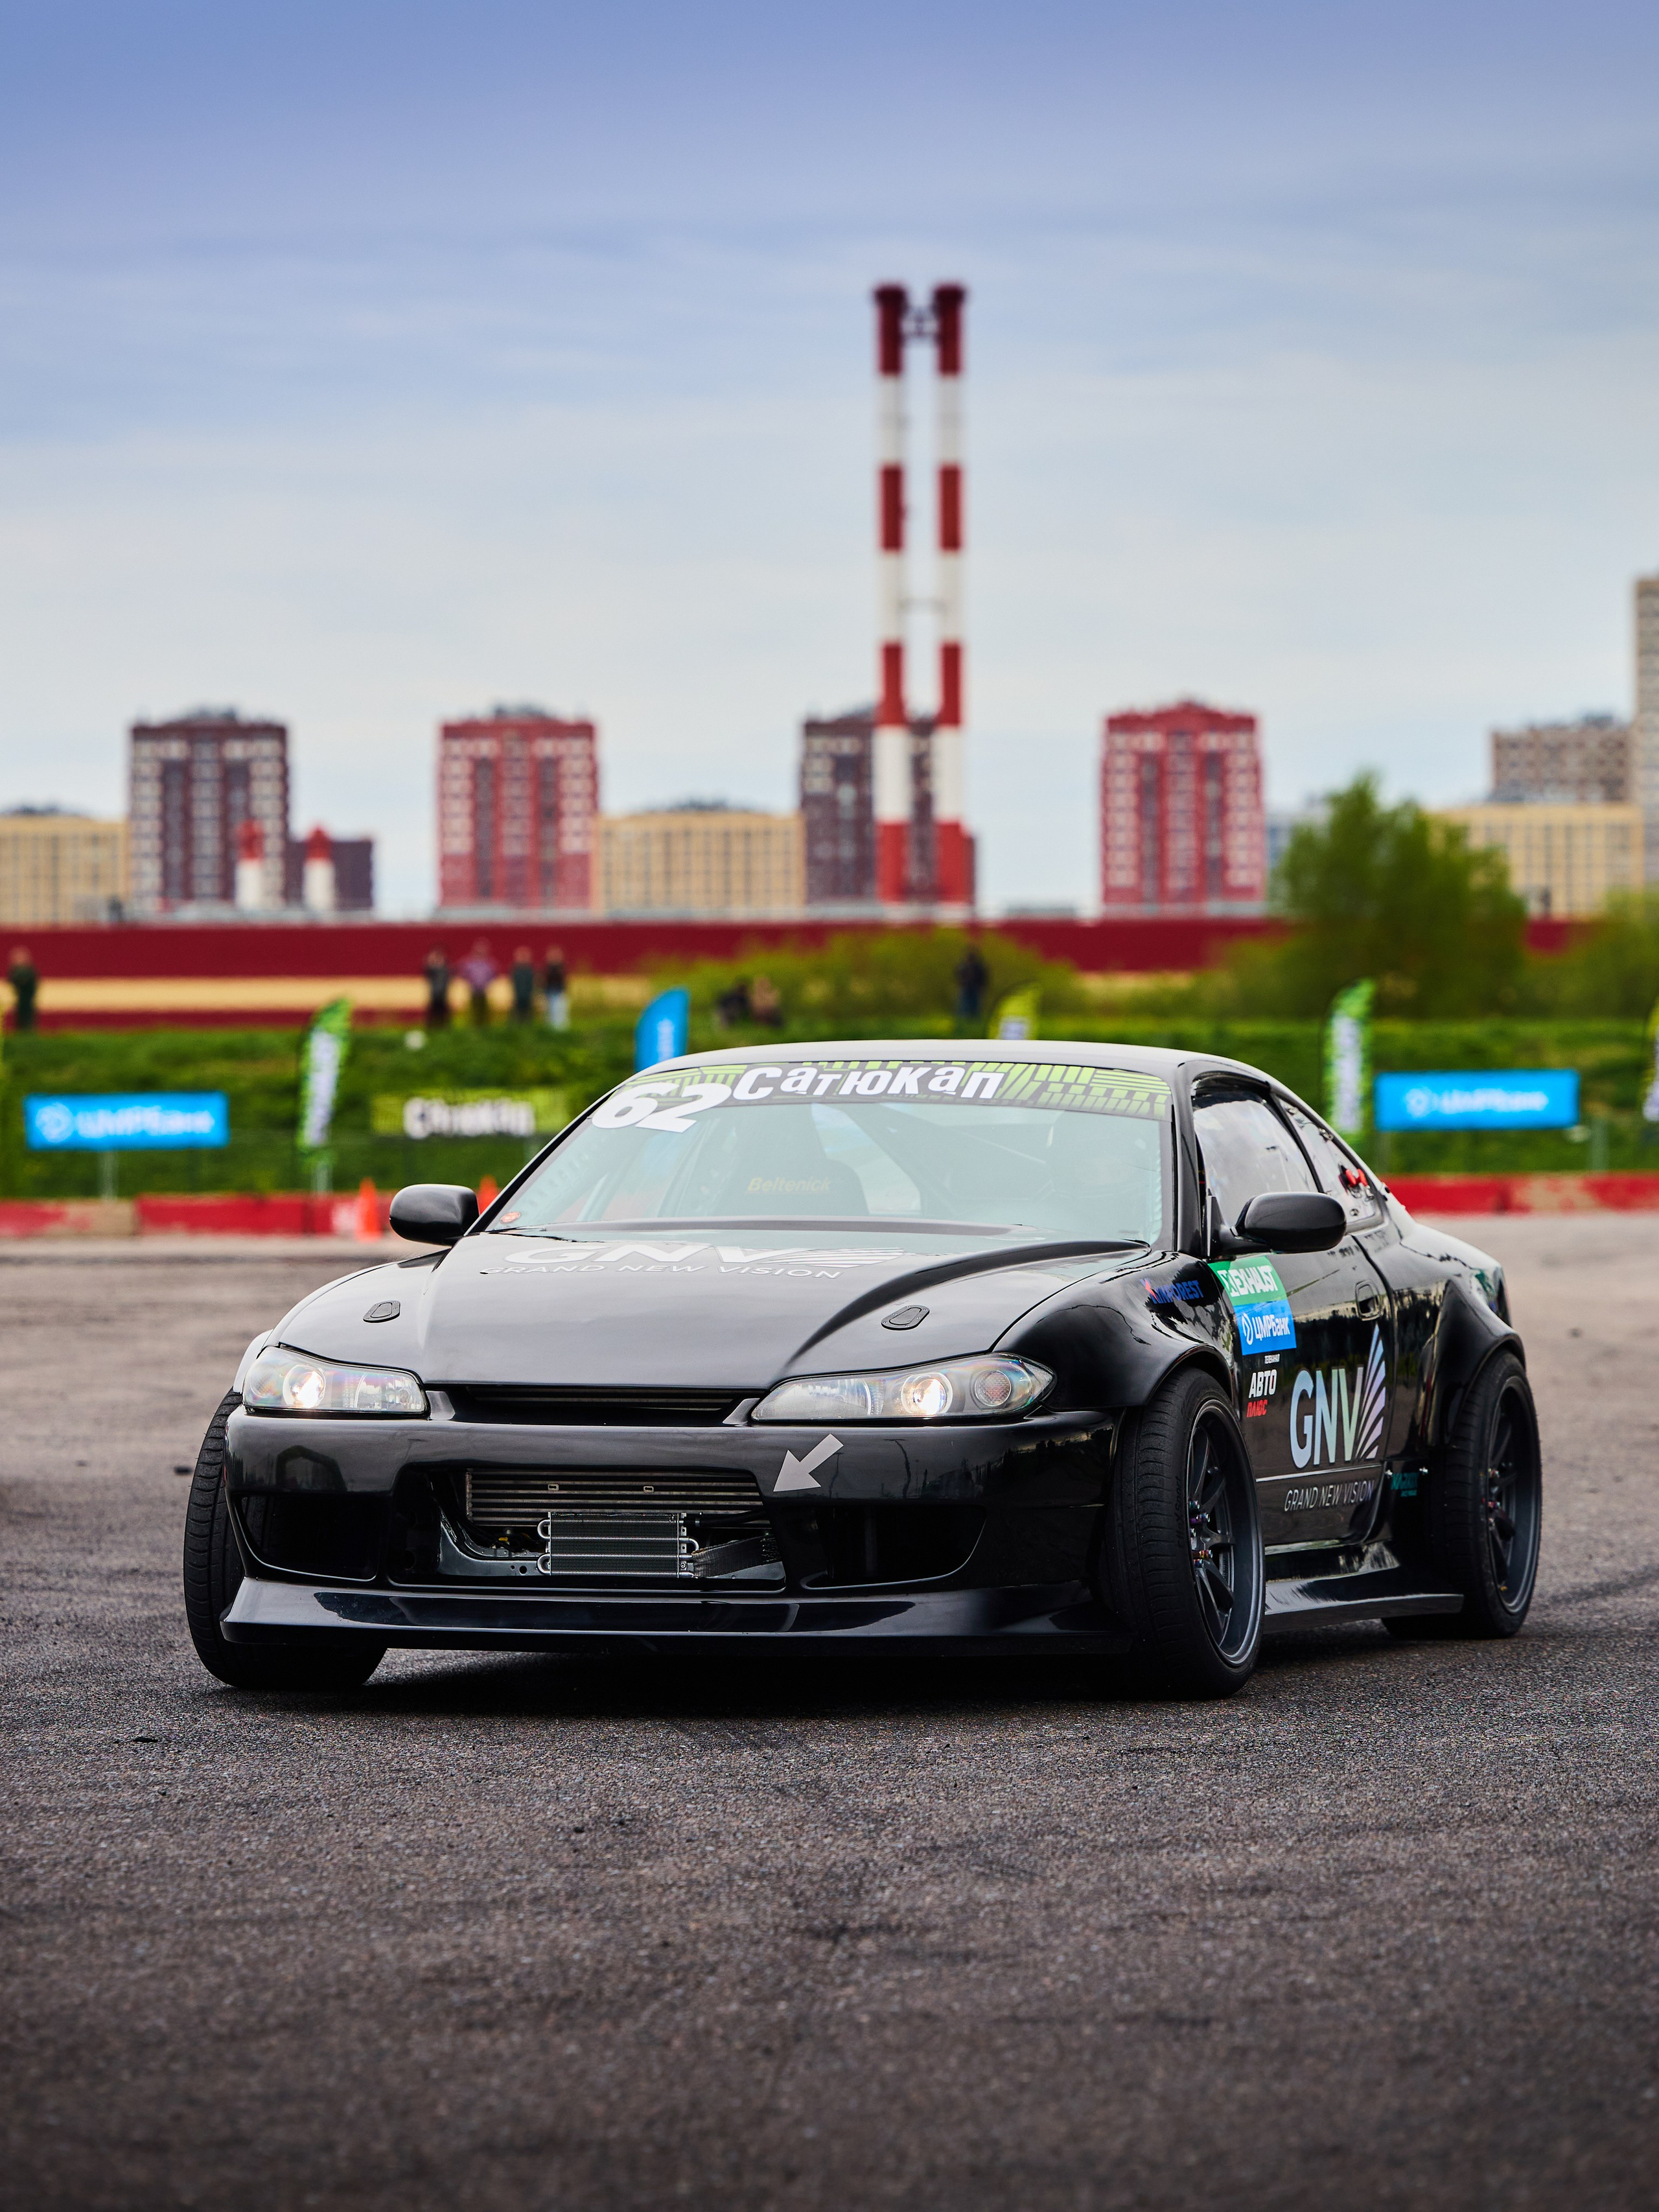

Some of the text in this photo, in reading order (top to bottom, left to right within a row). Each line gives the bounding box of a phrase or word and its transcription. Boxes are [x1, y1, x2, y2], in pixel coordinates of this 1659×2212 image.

[591, 1082, 732, 1133] 62
[747, 1170, 833, 1192] Beltenick
[503, 1244, 818, 1264] GNV
[480, 1264, 844, 1279] GRAND NEW VISION
[1252, 1314, 1290, 1340] ЦМРБанк
[1248, 1369, 1277, 1399] АВТО
[1290, 1366, 1364, 1469] GNV
[1284, 1485, 1319, 1512] GRAND
[1318, 1484, 1340, 1508] NEW
[1342, 1480, 1375, 1504] VISION
